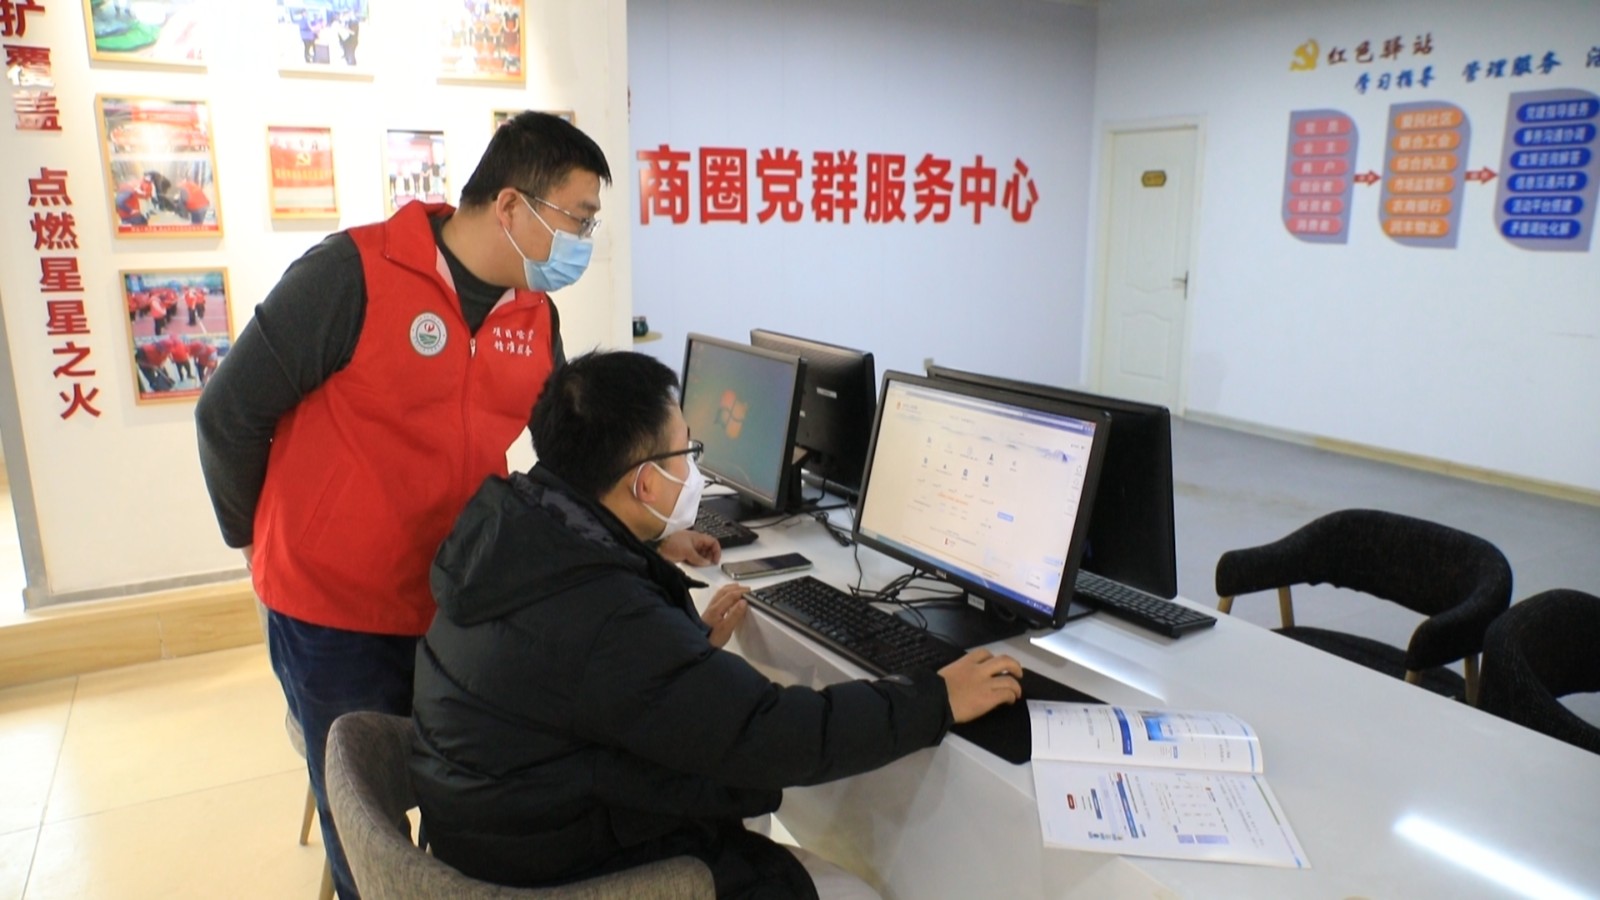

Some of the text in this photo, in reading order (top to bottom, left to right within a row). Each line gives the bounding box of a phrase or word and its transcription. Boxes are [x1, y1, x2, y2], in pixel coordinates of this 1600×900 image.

[1327, 33, 1434, 65] 红色驿站
[1354, 66, 1435, 94] 学习指导
[1461, 51, 1562, 83] 管理服务
[1524, 102, 1590, 121] 党建指导服务
[636, 144, 1039, 226] 商圈党群服务中心
[28, 167, 102, 420] 点燃星星之火
